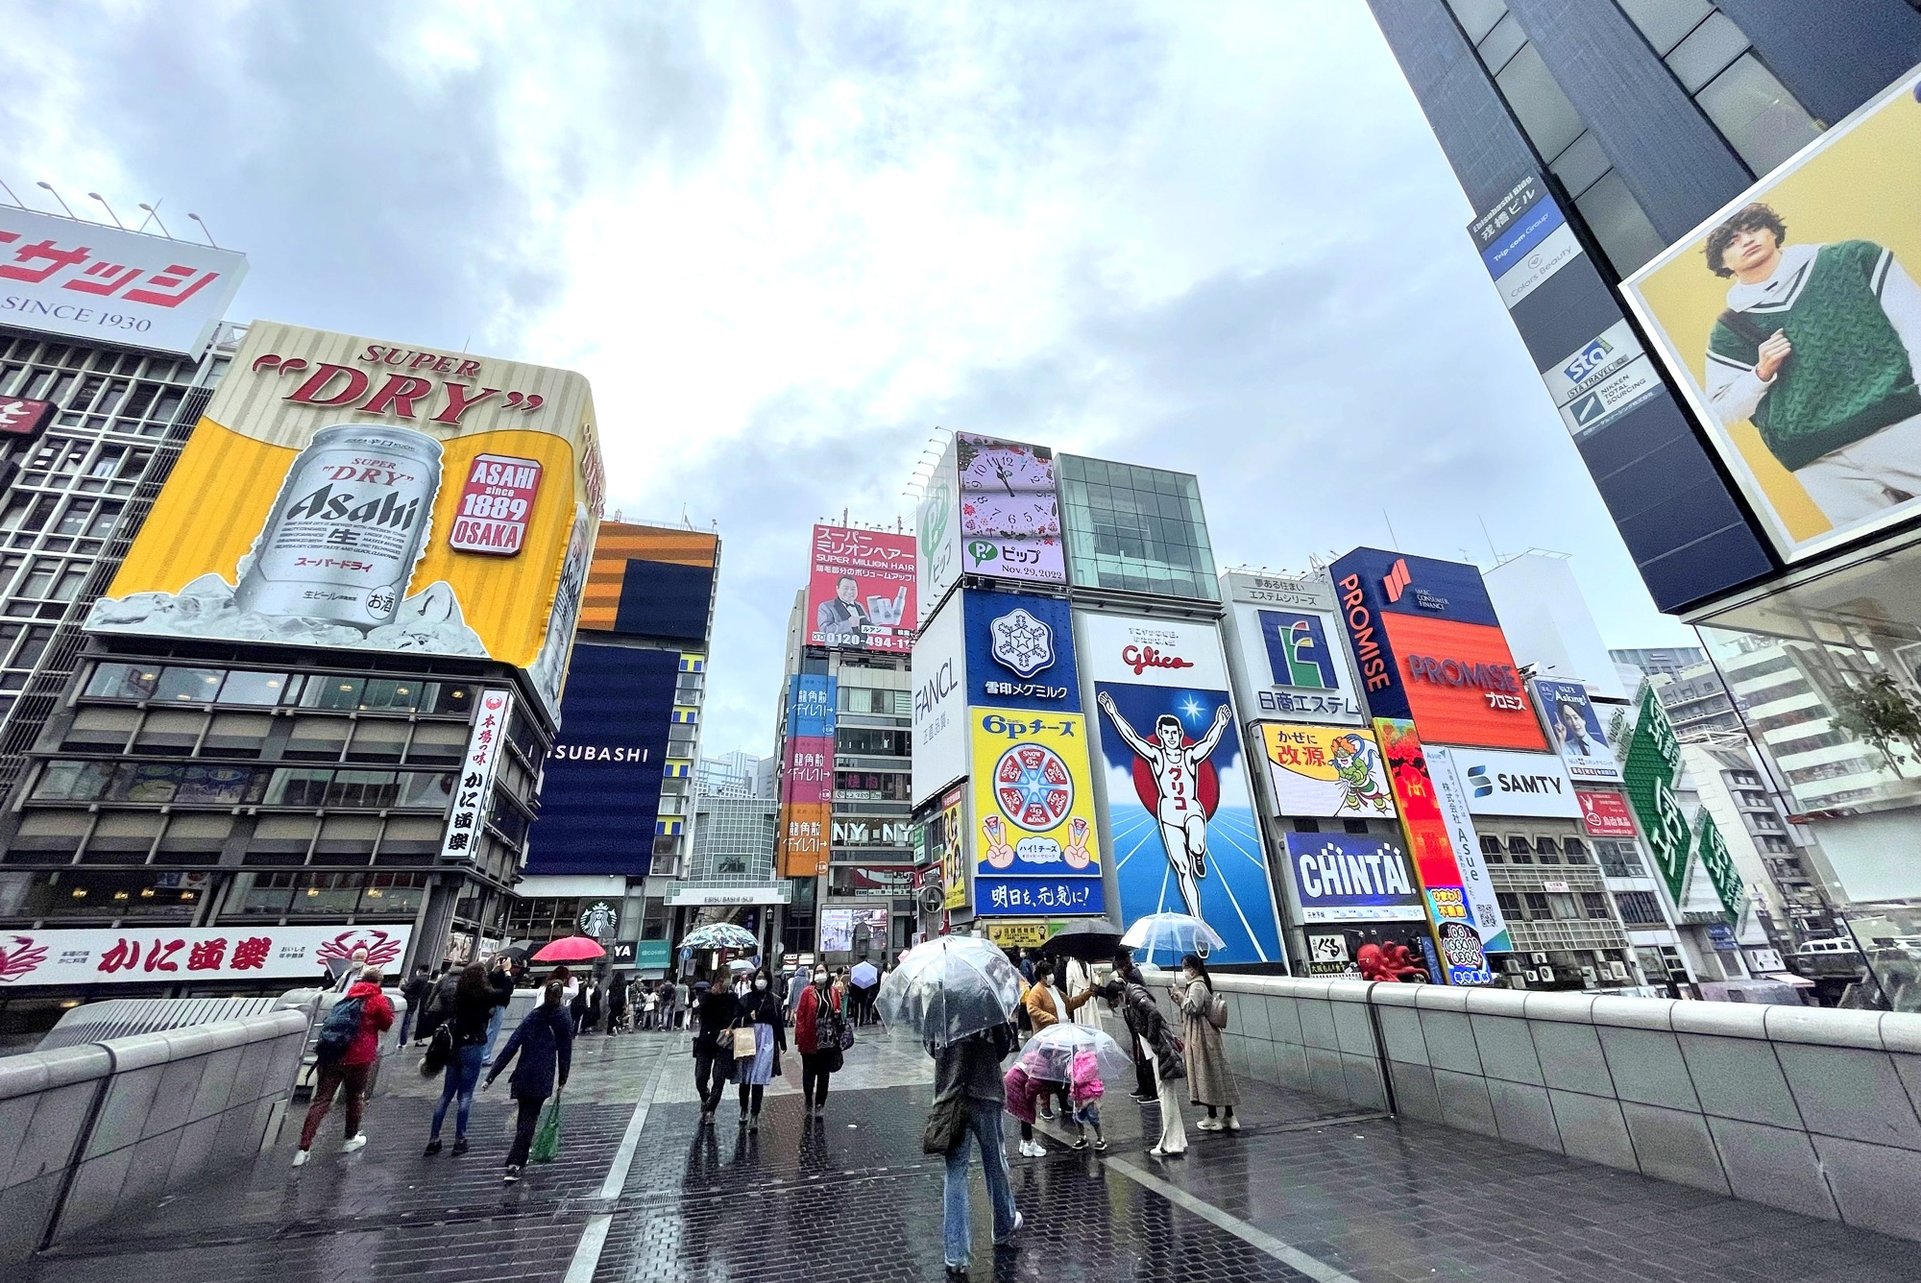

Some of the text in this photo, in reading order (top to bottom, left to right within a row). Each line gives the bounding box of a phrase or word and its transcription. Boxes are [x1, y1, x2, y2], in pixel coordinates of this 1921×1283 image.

[1481, 188, 1535, 241] 戎橋ビル
[1493, 212, 1549, 262] Trip.com Group
[1511, 245, 1572, 298] Colors Beauty
[1, 295, 152, 333] SINCE 1930
[359, 344, 482, 378] SUPER
[1600, 374, 1630, 395] NIKKEN
[1604, 383, 1629, 400] TOTAL
[1606, 378, 1646, 406] SOURCING
[352, 457, 396, 469] SUPER
[471, 462, 536, 490] ASAHI
[485, 485, 515, 497] since
[286, 483, 420, 531] Asahi
[463, 494, 528, 521] 1889
[326, 528, 361, 546] 生
[454, 520, 518, 549] OSAKA
[817, 527, 873, 543] スーパー
[816, 540, 915, 560] ミリオンヘアー
[1002, 546, 1041, 564] ピップ
[294, 557, 373, 573] スーパードライ
[816, 553, 915, 572] SUPER MILLION HAIR
[1002, 564, 1023, 574] Nov.
[1038, 569, 1062, 580] 2022
[1249, 590, 1317, 606] エステムシリーズ
[1338, 573, 1391, 693] PROMISE
[1122, 645, 1194, 675] Glico
[1408, 653, 1520, 693] PROMISE
[915, 656, 959, 726] FANCL
[984, 680, 1068, 699] 雪印メグミルク
[1485, 691, 1527, 711] プロミス
[1277, 731, 1318, 744] かぜに
[1275, 745, 1328, 767] 改源
[1168, 765, 1187, 810] グリコ
[1497, 773, 1562, 795] SAMTY
[1442, 782, 1462, 824] 株式会社
[1432, 889, 1462, 903] ひまわり
